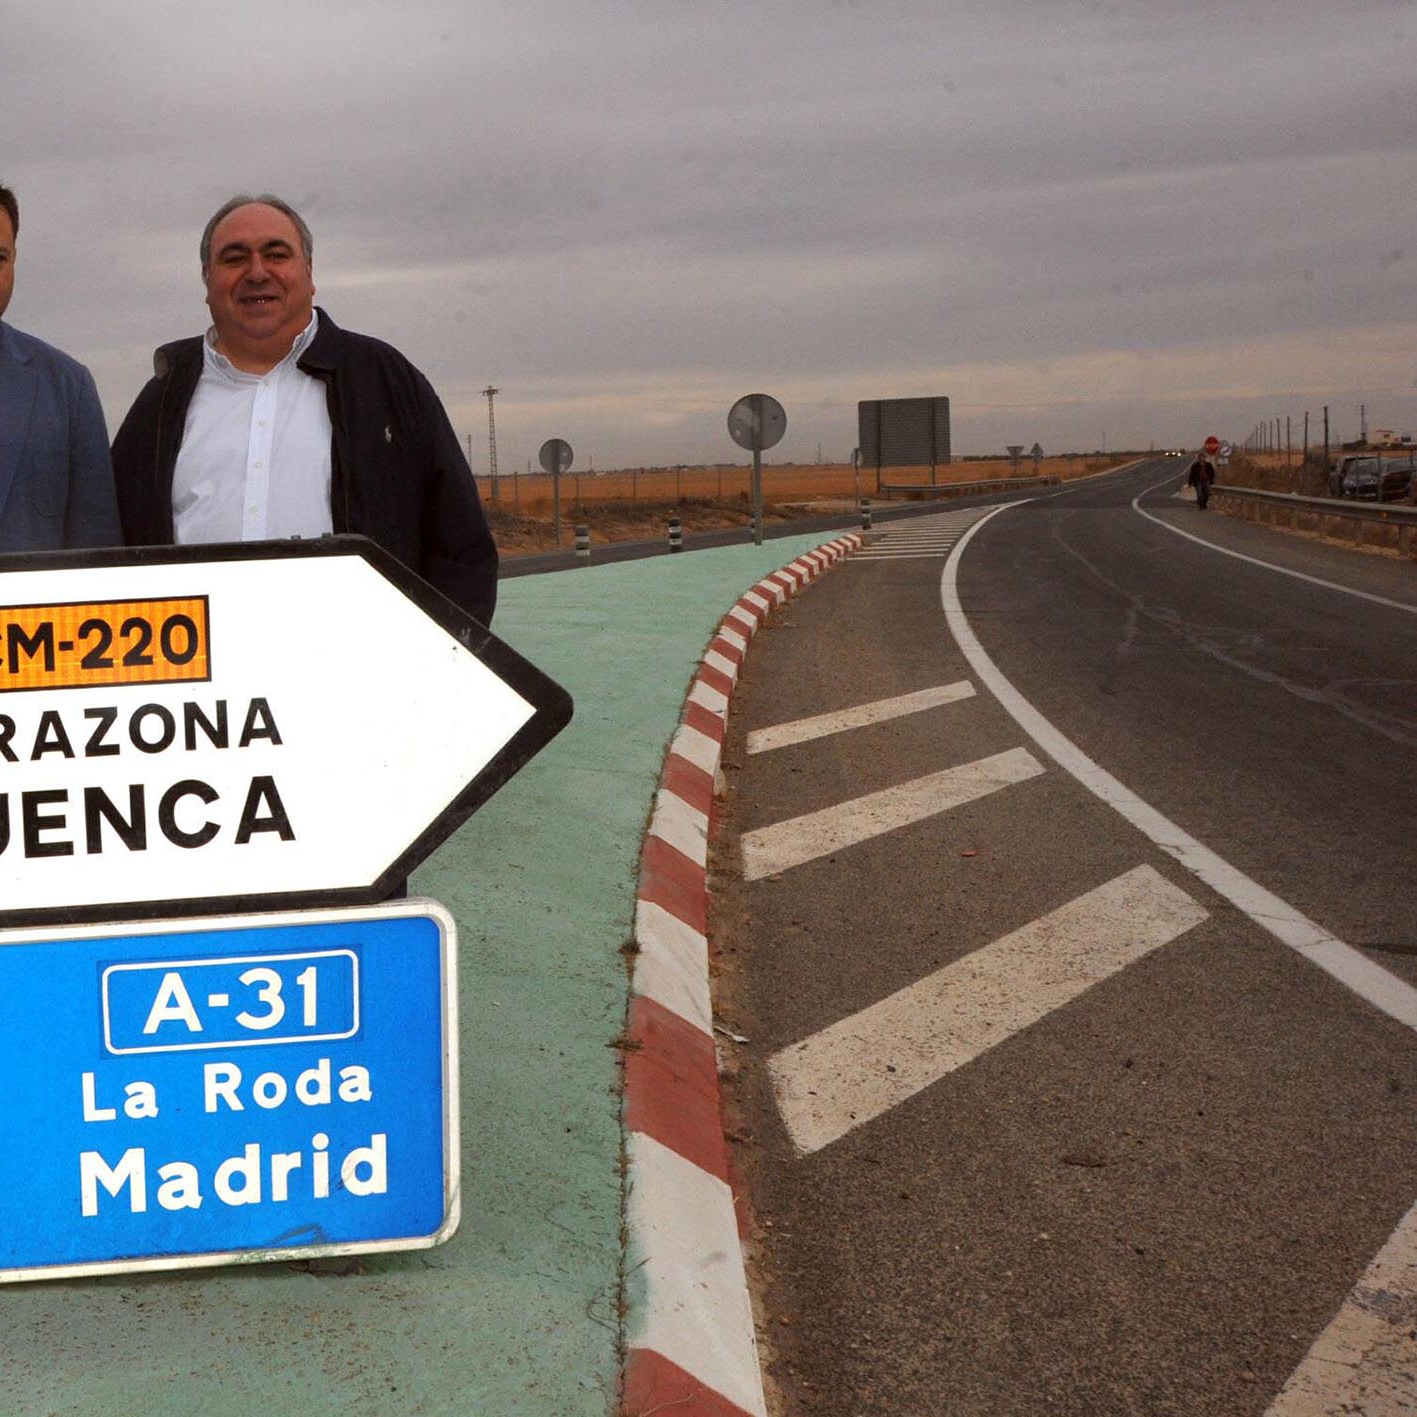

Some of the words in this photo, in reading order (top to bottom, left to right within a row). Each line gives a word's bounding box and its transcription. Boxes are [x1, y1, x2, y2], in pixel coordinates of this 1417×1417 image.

[142, 966, 317, 1034] A-31
[82, 1072, 159, 1122] La
[203, 1058, 373, 1113] Roda
[80, 1132, 388, 1217] Madrid
